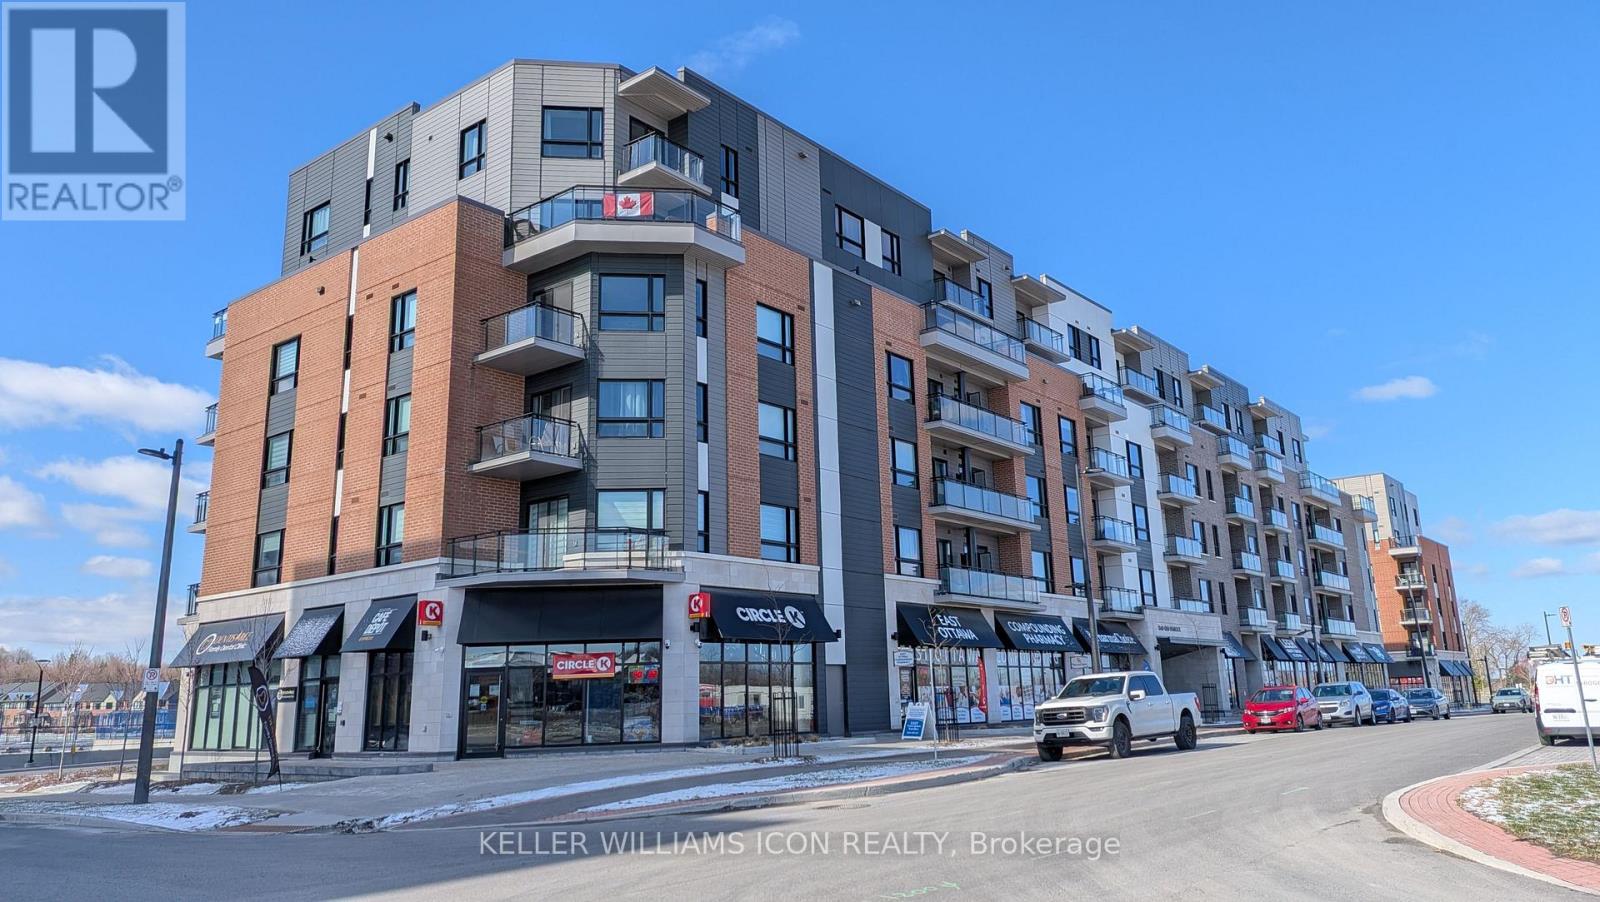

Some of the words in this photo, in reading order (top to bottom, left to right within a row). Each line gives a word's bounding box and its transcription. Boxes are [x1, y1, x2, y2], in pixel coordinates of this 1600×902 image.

[736, 607, 786, 623] CIRCLE
[784, 606, 806, 628] K
[938, 614, 962, 627] EAST
[938, 627, 979, 641] OTTAWA
[1007, 621, 1066, 635] COMPOUNDING
[1023, 633, 1066, 646] PHARMACY
[556, 660, 596, 671] CIRCLE
[597, 657, 611, 671] K
